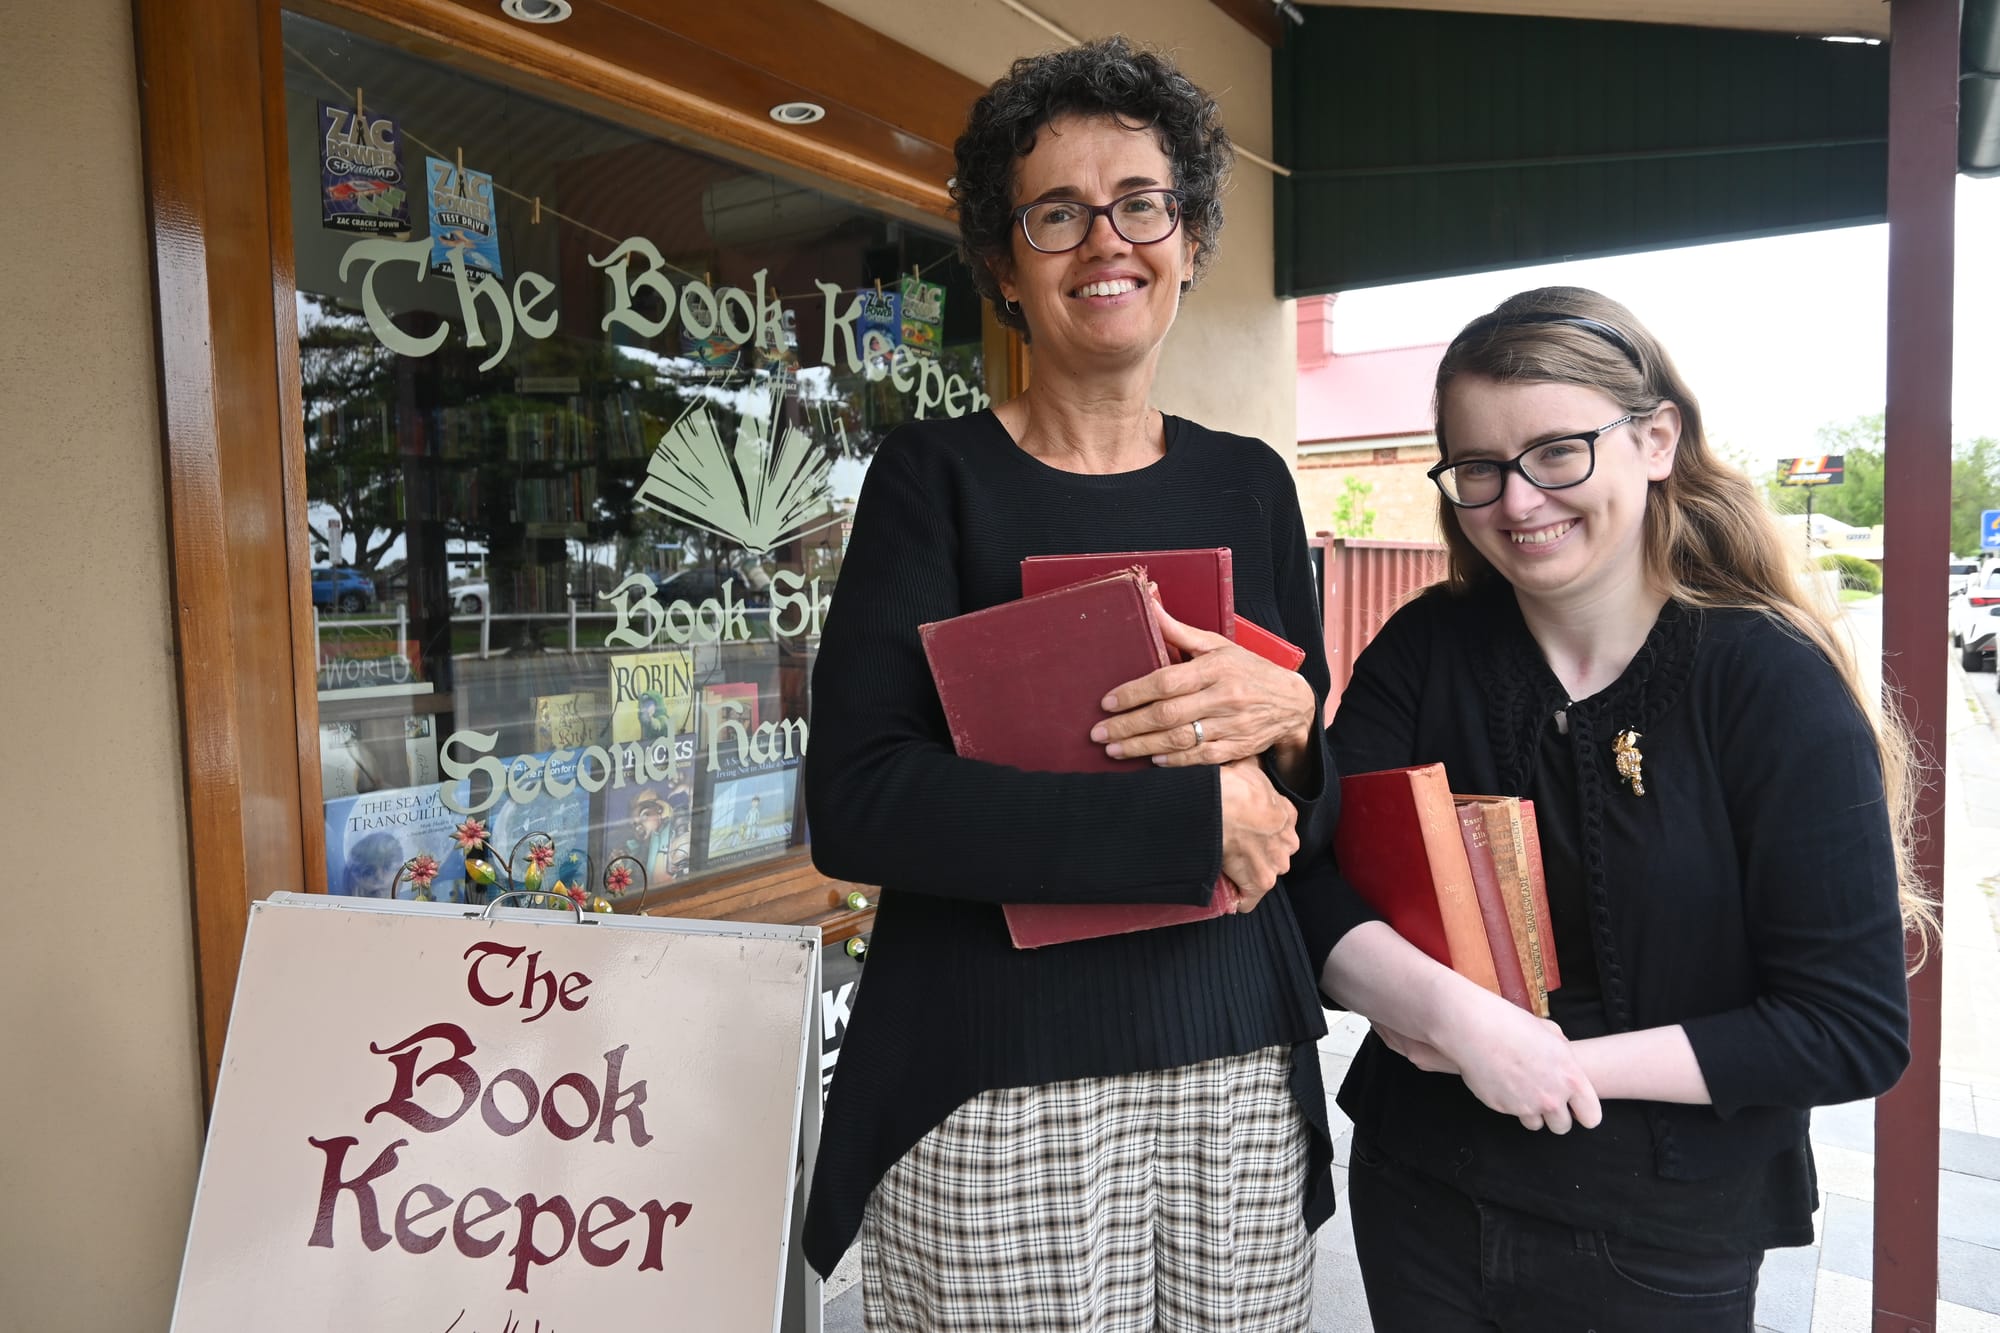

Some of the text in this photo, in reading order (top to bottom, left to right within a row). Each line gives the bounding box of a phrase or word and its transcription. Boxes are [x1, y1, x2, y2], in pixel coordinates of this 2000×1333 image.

[326, 106, 395, 152] ZAC
[433, 162, 489, 205] ZAC
[336, 216, 350, 225] ZAC
[352, 218, 377, 227] CRACKS
[378, 219, 400, 229] DOWN
[441, 213, 485, 232] TEST DRIVE
[866, 291, 895, 310] ZAC
[338, 236, 991, 420] The Book Keeper
[598, 569, 833, 649] Book Sh
[325, 653, 411, 690] WORLD
[616, 661, 691, 703] ROBIN
[439, 722, 677, 815] Second
[701, 699, 809, 773] han
[361, 788, 438, 816] THE SEA of
[1519, 875, 1537, 934] SHAKESPEARE
[463, 940, 593, 1023] The
[363, 1022, 654, 1147] Book
[306, 1135, 693, 1294] Keeper
